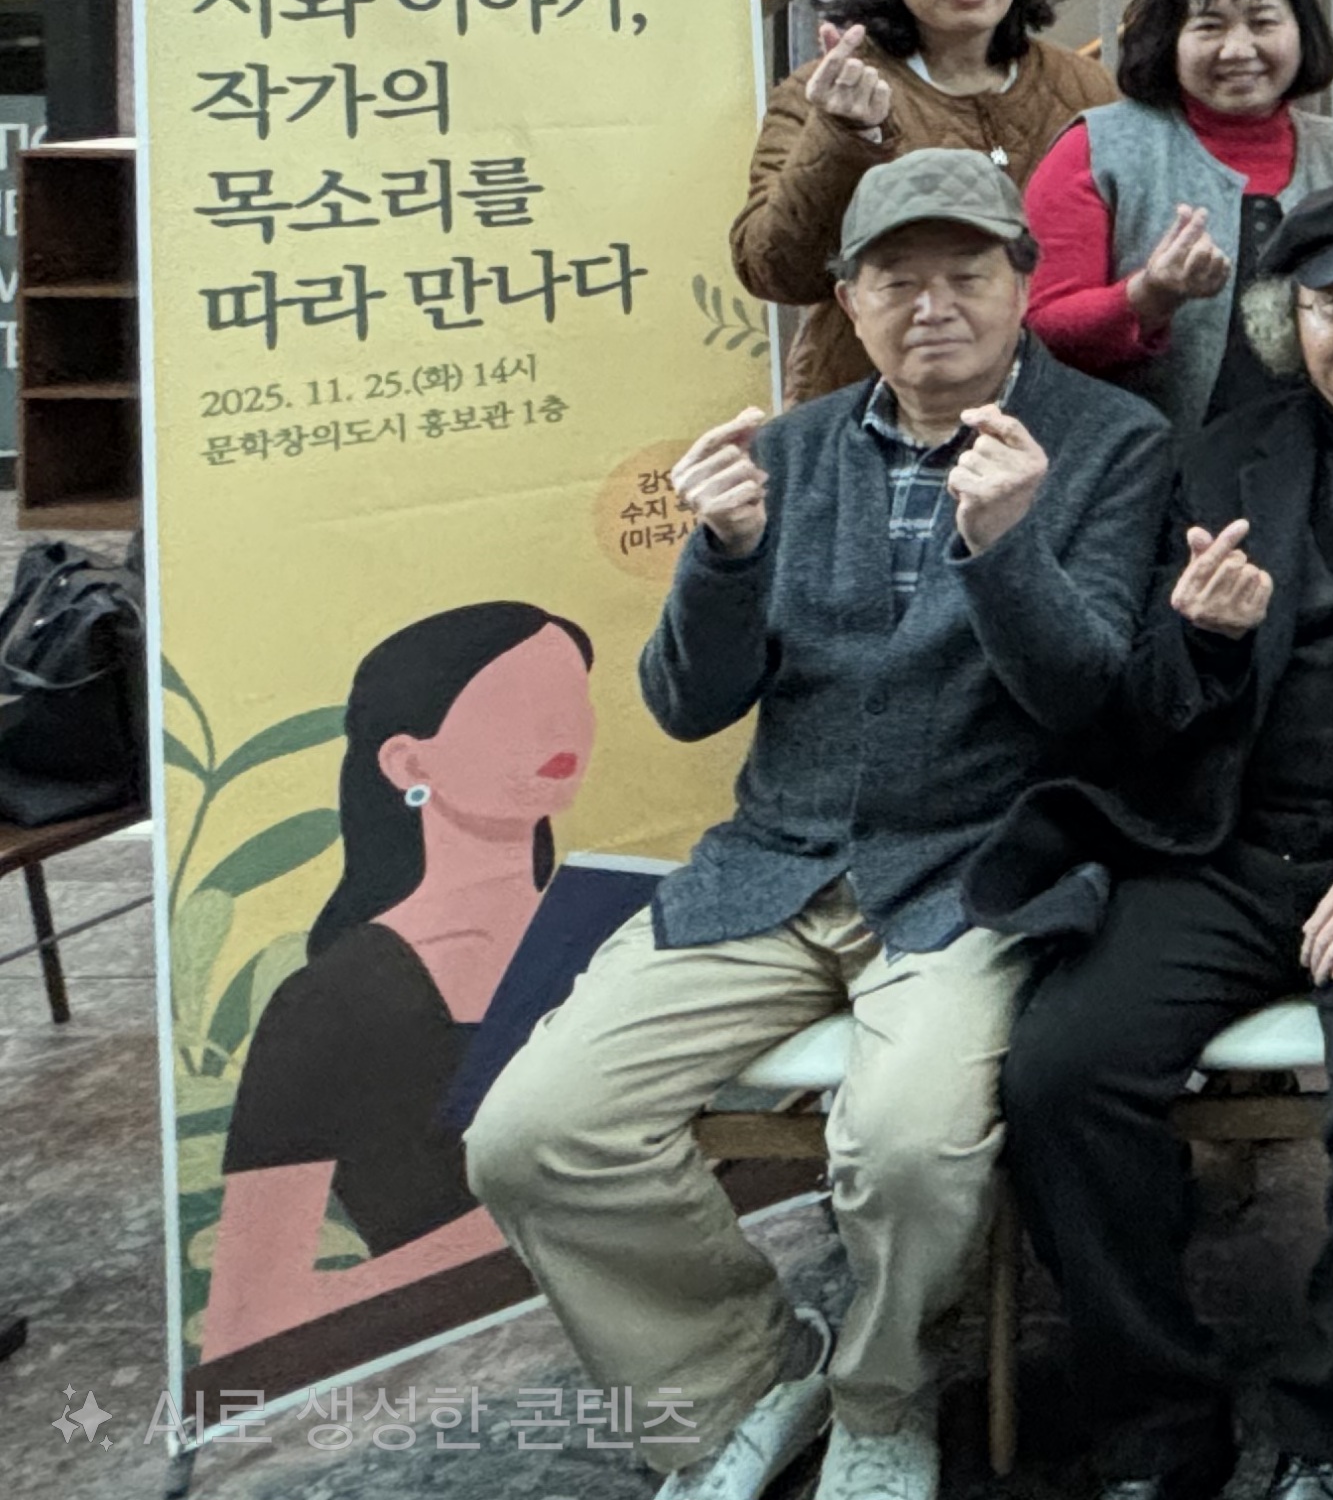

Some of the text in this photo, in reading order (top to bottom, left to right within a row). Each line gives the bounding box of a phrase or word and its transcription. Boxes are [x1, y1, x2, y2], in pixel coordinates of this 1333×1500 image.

[191, 59, 449, 140] 작가의
[194, 157, 545, 245] 목소리를
[199, 242, 649, 351] 따라 만나다
[201, 384, 293, 418] 2025.
[307, 377, 354, 406] 11.
[475, 353, 537, 387] 14시
[202, 394, 570, 466] 문학창의도시 홍보관 1층
[620, 497, 668, 525] 수지
